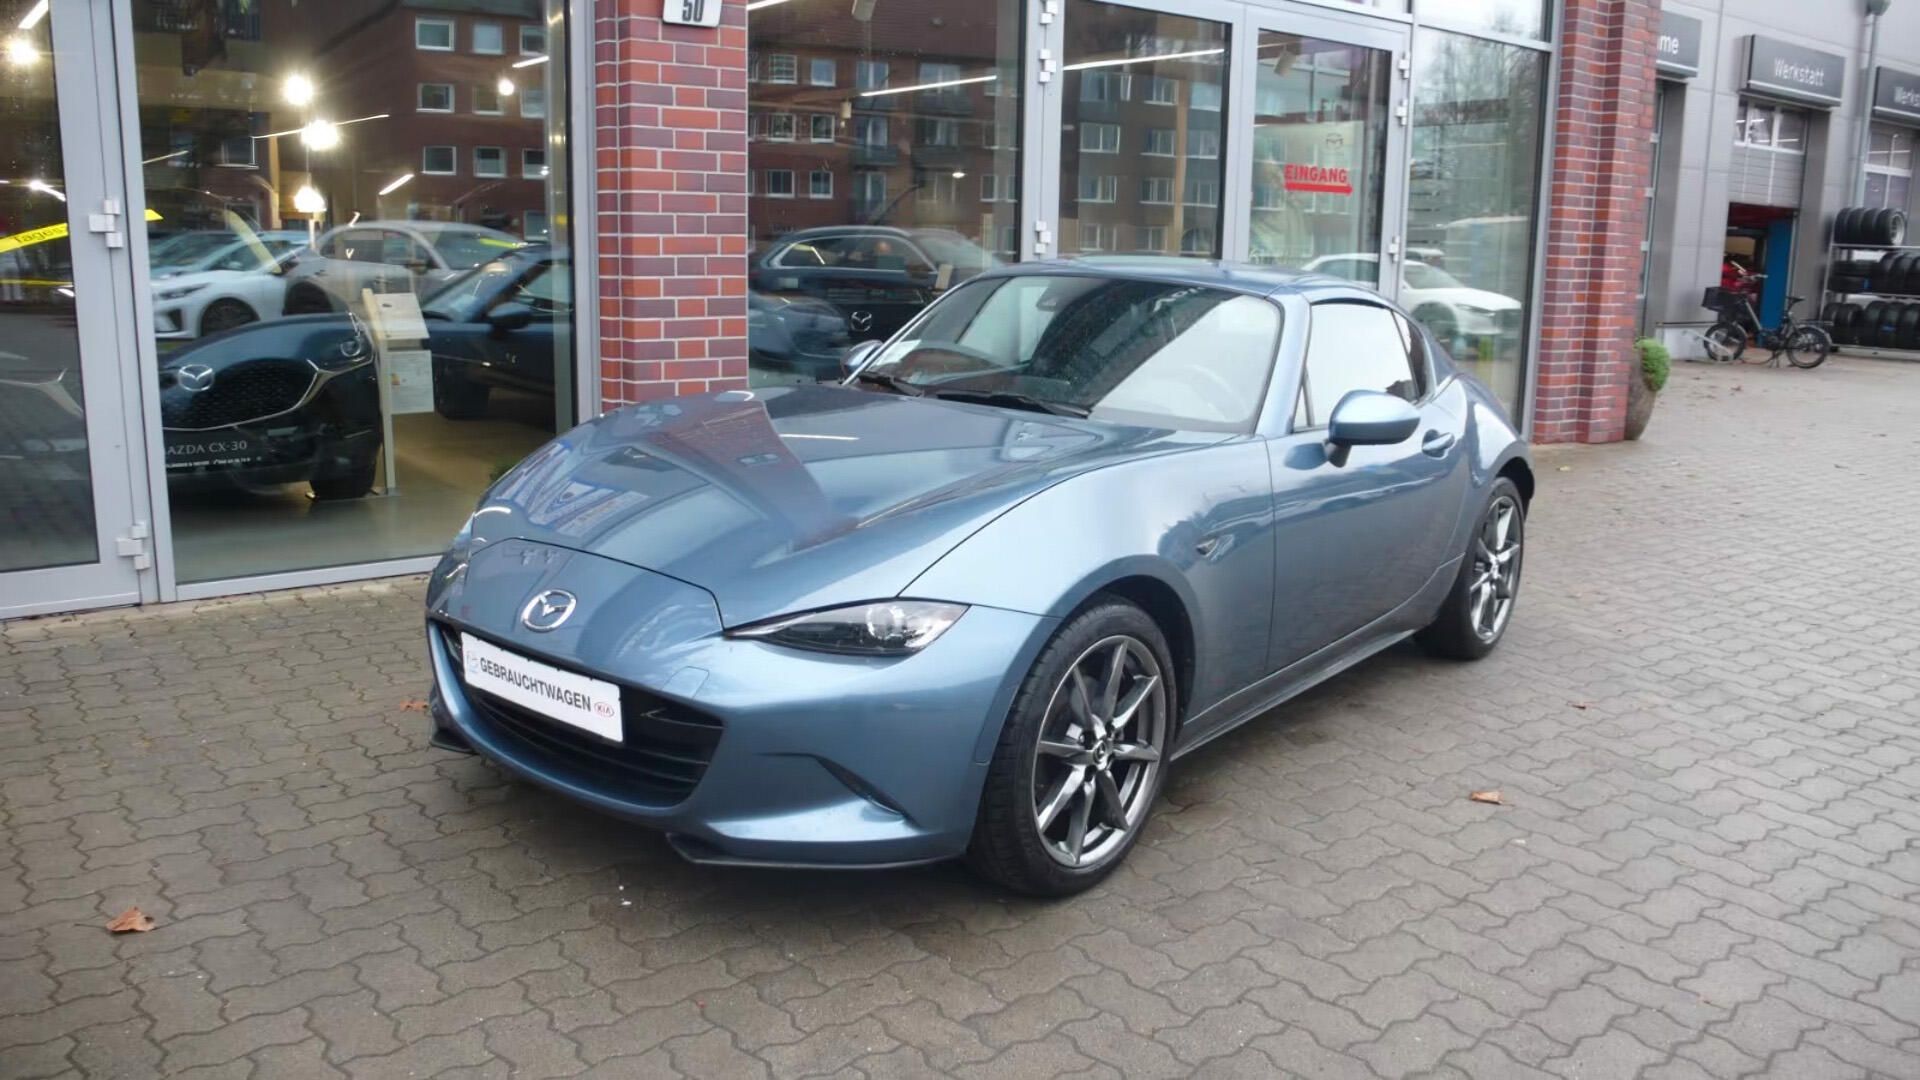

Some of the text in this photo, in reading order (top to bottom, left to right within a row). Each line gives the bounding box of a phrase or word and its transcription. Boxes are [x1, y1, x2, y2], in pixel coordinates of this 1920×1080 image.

[681, 0, 705, 22] 50
[1657, 35, 1679, 55] me
[1774, 57, 1824, 87] Werkstatt
[1894, 86, 1920, 107] Werks
[1284, 163, 1348, 183] EINGANG
[167, 440, 248, 455] AZDA CX-30
[480, 657, 592, 713] GEBRAUCHTWAGEN
